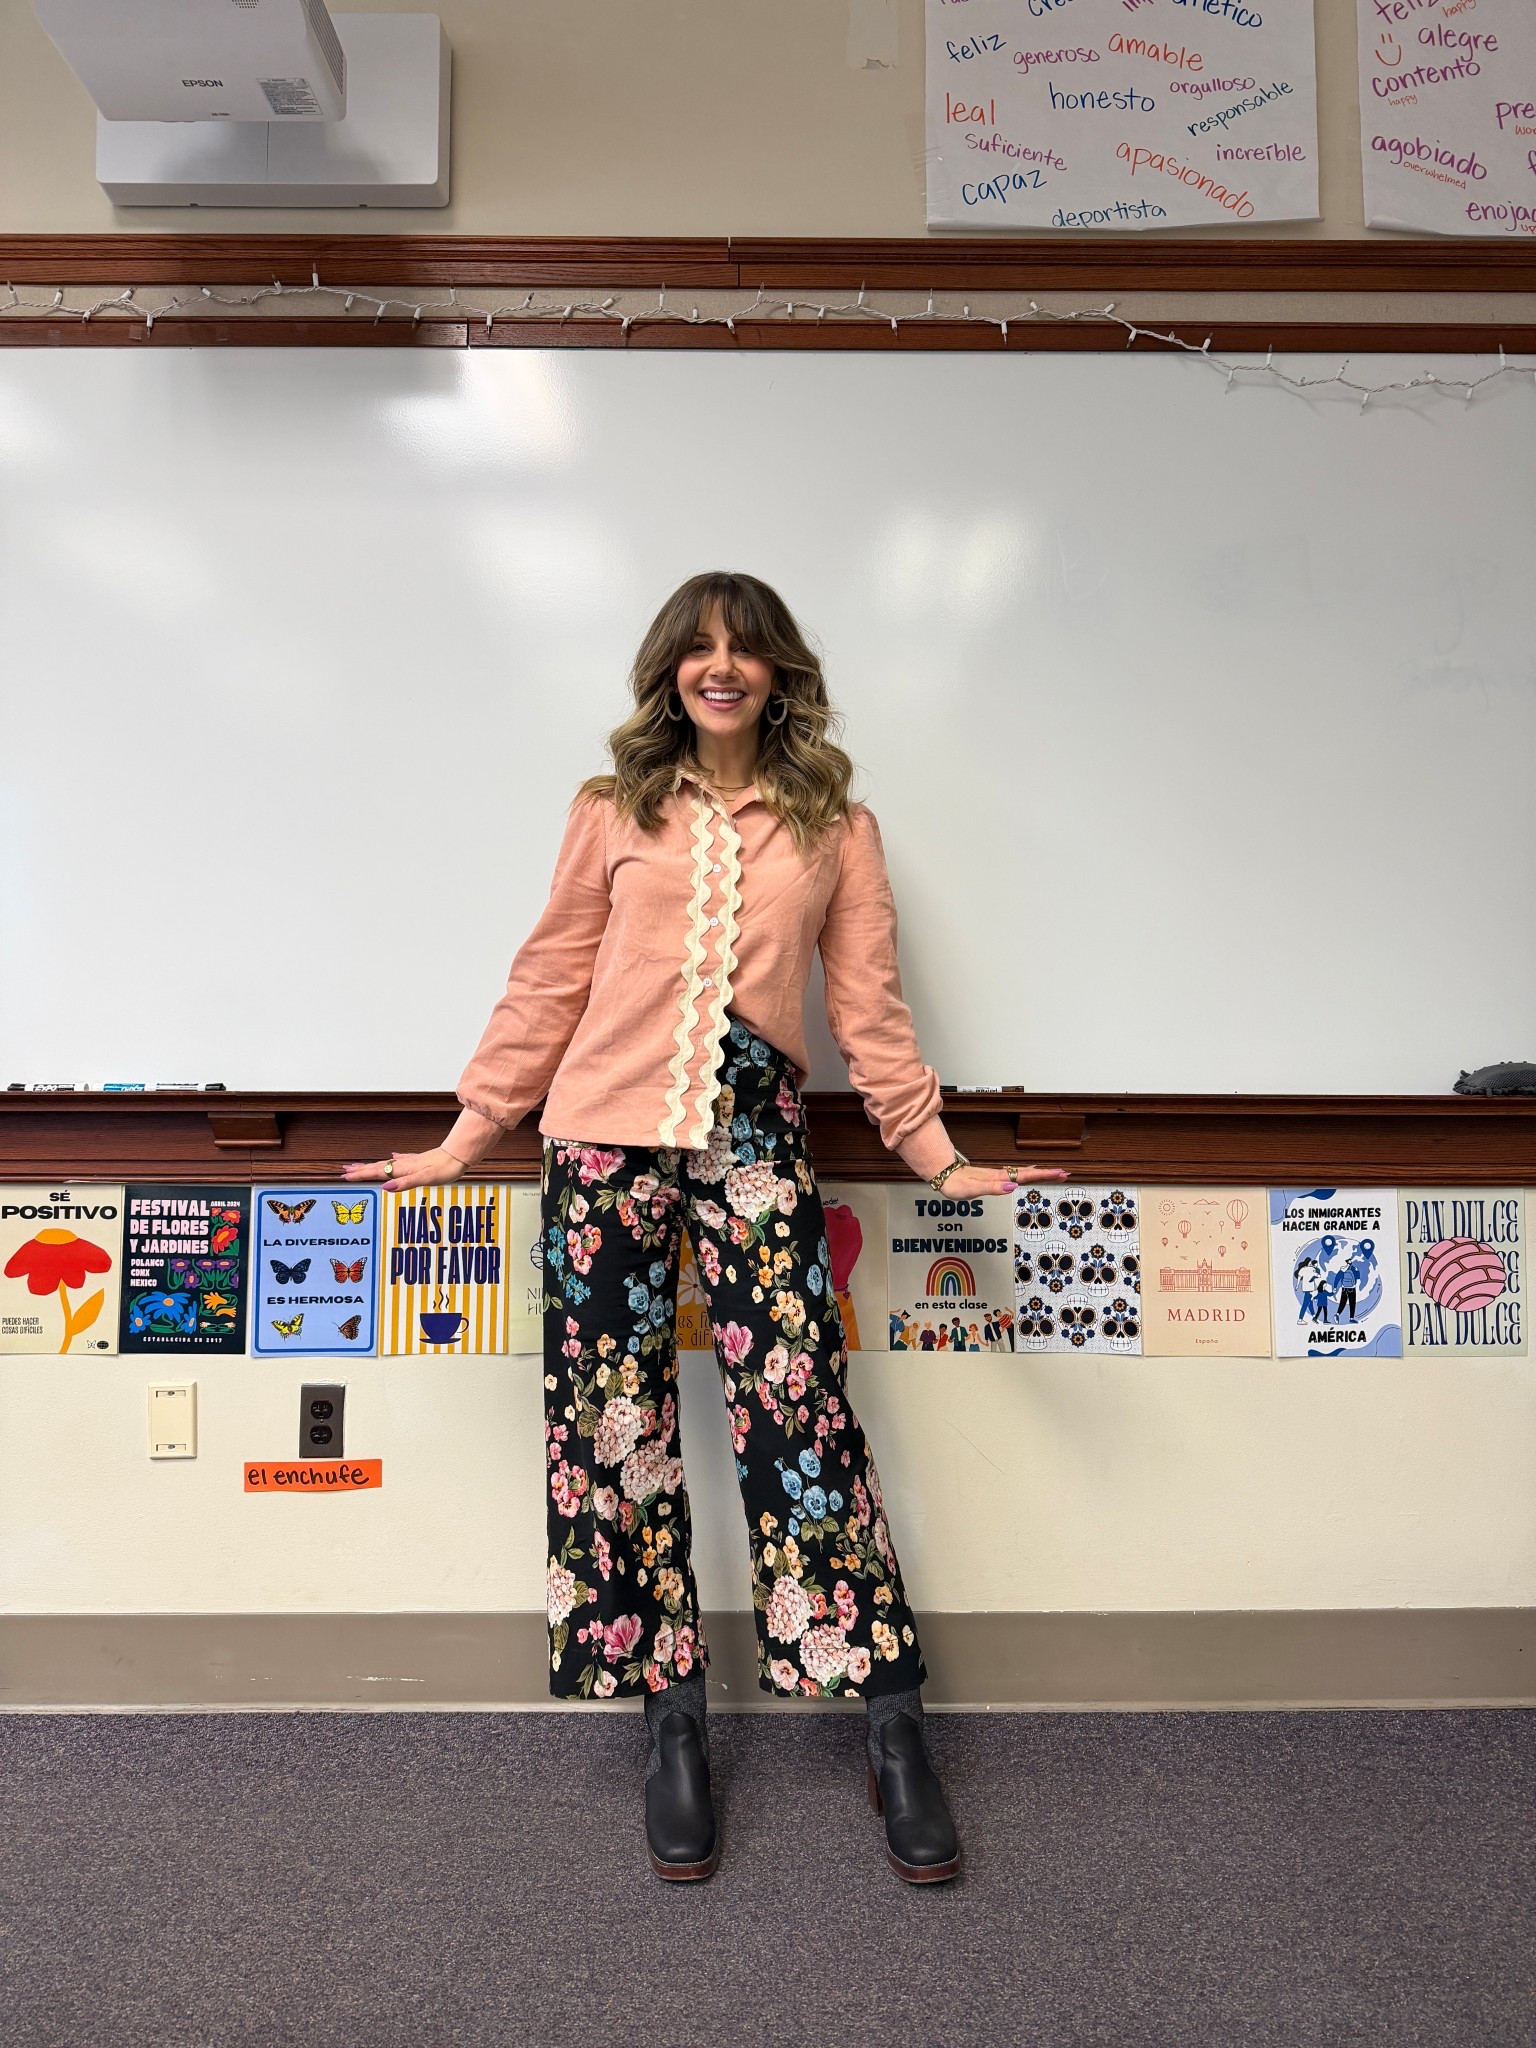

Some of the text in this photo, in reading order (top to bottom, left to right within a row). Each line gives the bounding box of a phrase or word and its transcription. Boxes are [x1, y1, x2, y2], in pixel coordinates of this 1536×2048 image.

[946, 33, 1007, 63] feliz
[1418, 24, 1499, 62] alegre
[1013, 46, 1101, 74] generoso
[1108, 33, 1204, 71] amable
[182, 79, 224, 88] EPSON
[1372, 58, 1481, 98] contento
[1170, 75, 1256, 100] orgulloso
[1049, 82, 1155, 112] honesto
[1388, 93, 1418, 107] happy
[946, 93, 995, 126] leal
[1187, 80, 1294, 136] responsable
[1216, 143, 1306, 161] increíble
[1371, 135, 1488, 180] agobiado
[1116, 142, 1255, 218] apasionado
[1403, 161, 1467, 190] overwhelmed
[962, 168, 1047, 205] capaz
[1052, 198, 1167, 228] deportista
[49, 1189, 71, 1202] SÉ
[1, 1205, 118, 1220] POSITIVO
[130, 1199, 210, 1217] FESTIVAL
[915, 1200, 984, 1217] TODOS
[1285, 1207, 1381, 1219] LOS INMIGRANTES
[130, 1219, 209, 1236] DE FLORES
[398, 1197, 496, 1244] MÁS CAFÉ
[937, 1222, 963, 1233] son
[1283, 1220, 1381, 1232] HACEN GRANDE A
[1406, 1200, 1519, 1243] PAN DULCE
[130, 1239, 209, 1255] Y JARDINES
[263, 1238, 370, 1247] LA DIVERSIDAD
[892, 1238, 1008, 1253] BIENVENIDOS
[130, 1258, 165, 1267] POLANCO
[391, 1246, 501, 1285] POR FAVOR
[130, 1269, 150, 1277] CDMX
[130, 1279, 158, 1287] MEXICO
[267, 1295, 364, 1305] ES HERMOSA
[915, 1298, 988, 1310] en esta clase
[2, 1317, 40, 1325] PUEDES HACER
[1167, 1308, 1246, 1323] MADRID
[1408, 1302, 1521, 1345] PAN DULCE
[2, 1326, 18, 1334] COSAS
[1308, 1328, 1367, 1343] AMÉRICA
[248, 1464, 370, 1486] el enchufe
